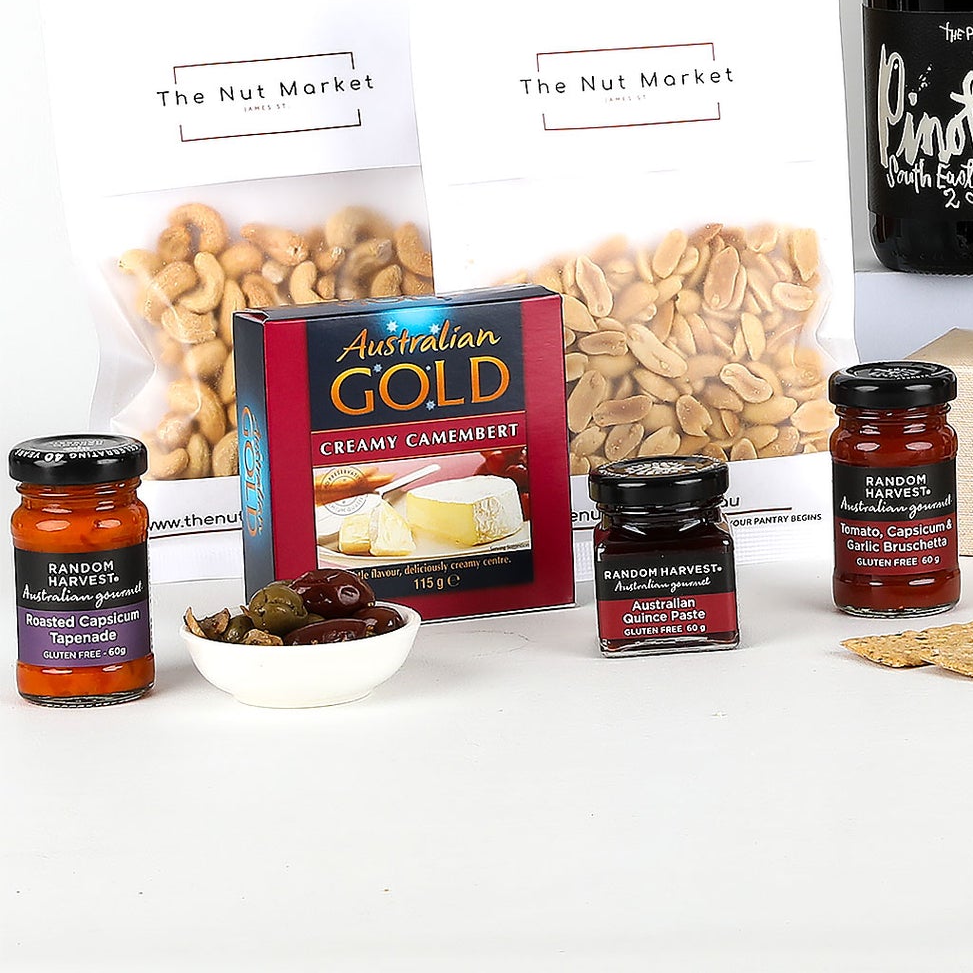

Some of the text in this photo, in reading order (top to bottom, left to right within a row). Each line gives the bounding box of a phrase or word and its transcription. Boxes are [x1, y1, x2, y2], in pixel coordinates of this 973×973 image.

[520, 68, 734, 95] The Nut Market
[157, 75, 374, 107] The Nut Market
[886, 154, 932, 194] South
[336, 320, 501, 363] Australian
[330, 355, 510, 416] GOLD
[319, 423, 519, 457] CREAMY CAMEMBERT
[44, 452, 65, 462] 40
[866, 474, 927, 487] RANDOM
[840, 495, 908, 513] Australian
[754, 515, 790, 526] PANTRY
[790, 513, 822, 523] BEGINS
[840, 518, 953, 539] Tomato, Capsicum &
[846, 537, 948, 553] Garlic Bruschetta
[48, 560, 115, 575] RANDOM
[371, 566, 403, 578] flavour,
[404, 560, 449, 575] deliciously
[450, 559, 481, 571] creamy
[482, 555, 512, 567] centre.
[855, 556, 940, 567] GLUTEN FREE 60 g
[604, 567, 658, 581] RANDOM
[413, 577, 434, 590] 115
[436, 578, 444, 590] g
[614, 576, 711, 593] Australian gourmet
[22, 579, 144, 608] Australian gourmet
[631, 597, 696, 612] Australian
[26, 608, 141, 629] Roasted Capsicum
[622, 610, 706, 624] Quince Paste
[49, 630, 118, 646] Tapenade
[624, 624, 706, 637] GLUTEN FREE 60 g
[43, 650, 77, 660] GLUTEN
[78, 649, 102, 660] FREE
[108, 646, 127, 658] 60g
